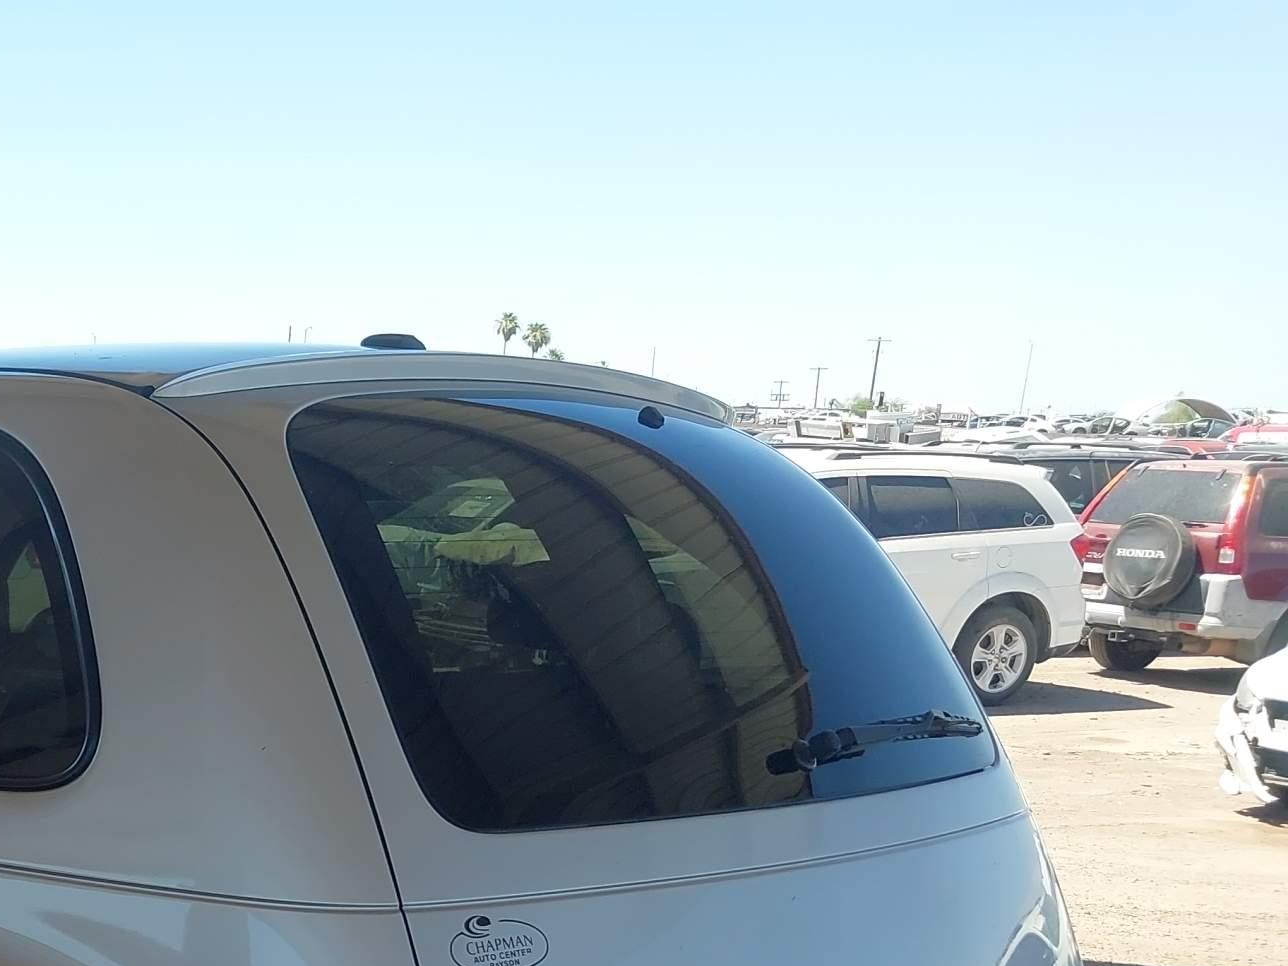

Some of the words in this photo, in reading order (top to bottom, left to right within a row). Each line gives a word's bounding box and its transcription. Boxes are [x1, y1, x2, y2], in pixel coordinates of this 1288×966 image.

[1115, 547, 1168, 559] HONDA
[466, 934, 534, 956] CHAPMAN
[473, 953, 497, 964] AUTO
[498, 948, 533, 960] CENTER
